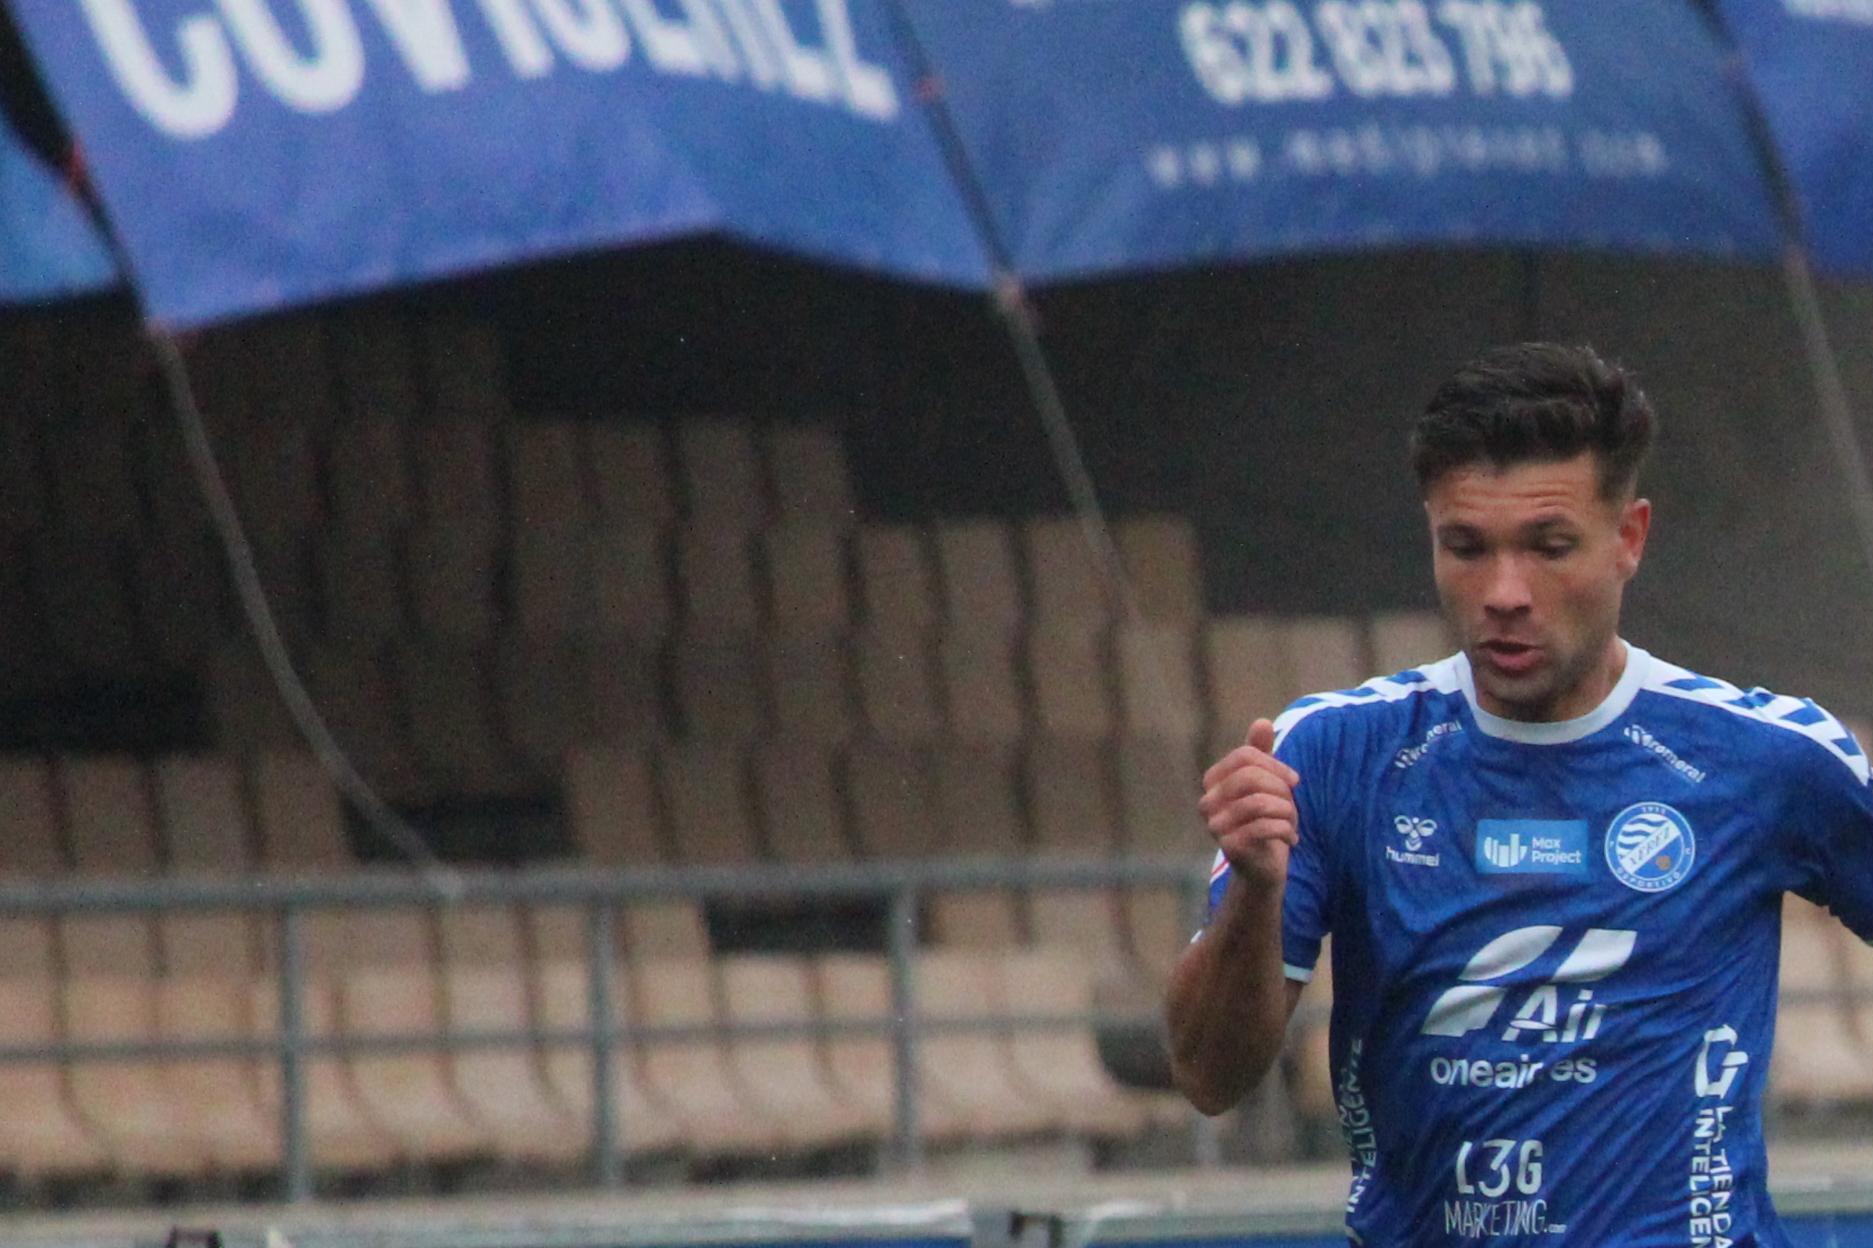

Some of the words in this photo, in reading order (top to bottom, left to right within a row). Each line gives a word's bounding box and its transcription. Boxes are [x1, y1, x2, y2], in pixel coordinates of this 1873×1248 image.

[1532, 836, 1561, 850] Max
[1386, 846, 1440, 867] hummel
[1531, 850, 1582, 865] Project
[1456, 1139, 1543, 1197] L3G
